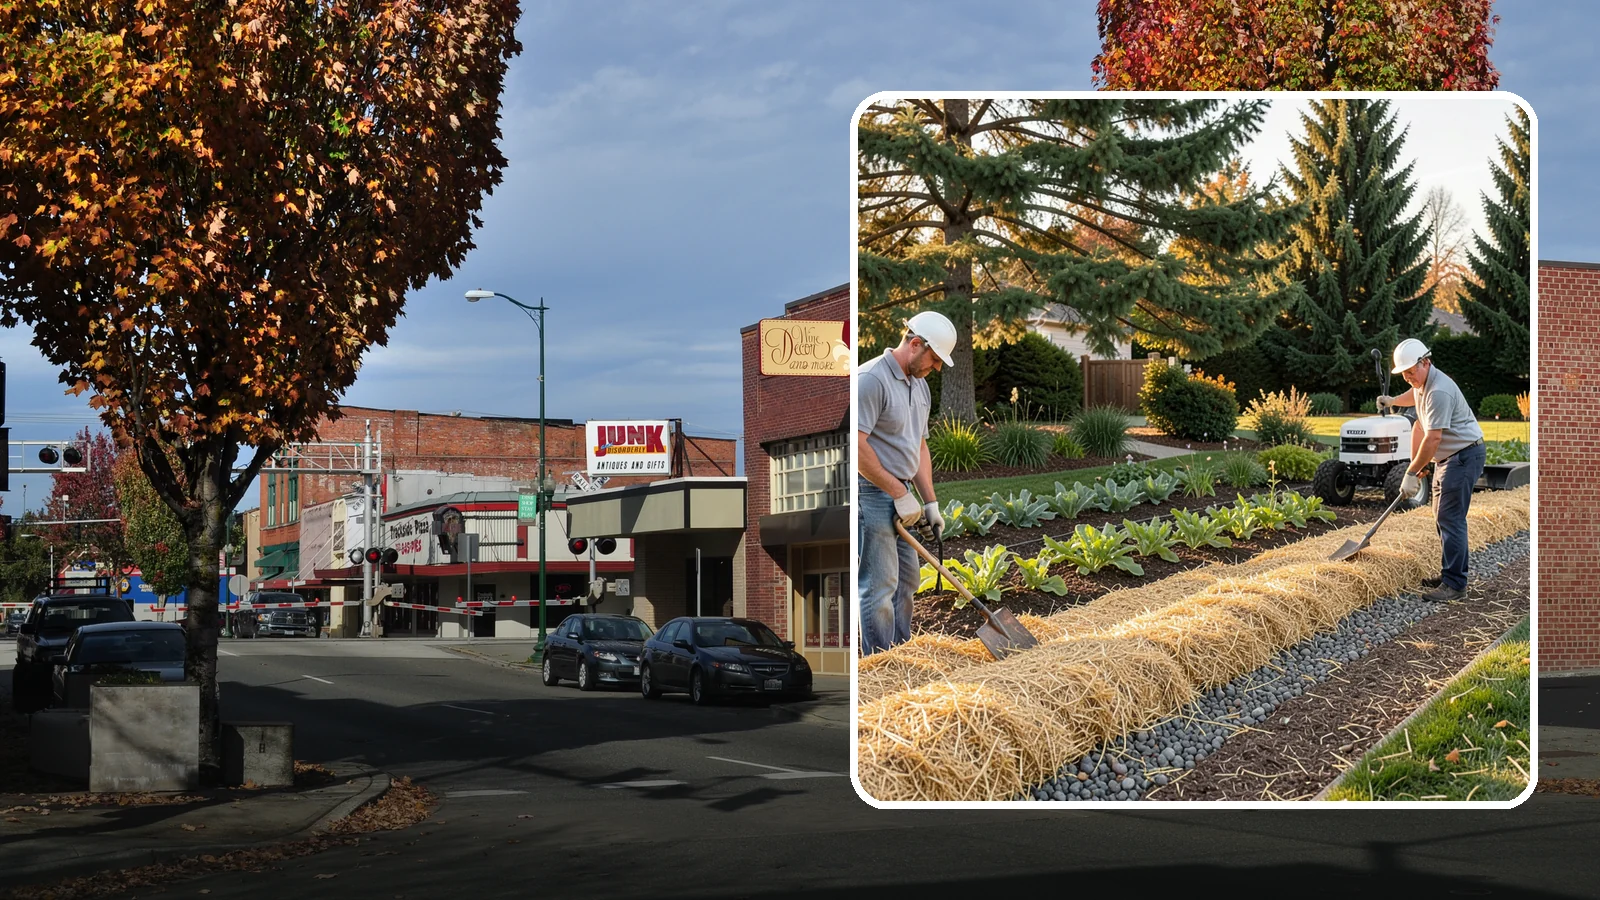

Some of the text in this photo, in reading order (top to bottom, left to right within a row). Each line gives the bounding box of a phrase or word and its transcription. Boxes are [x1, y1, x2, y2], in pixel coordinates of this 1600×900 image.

[765, 328, 831, 365] Decor
[595, 425, 665, 457] JUNK
[596, 460, 665, 470] ANTIQUES AND GIFTS
[390, 519, 429, 540] Trackside Pizza
